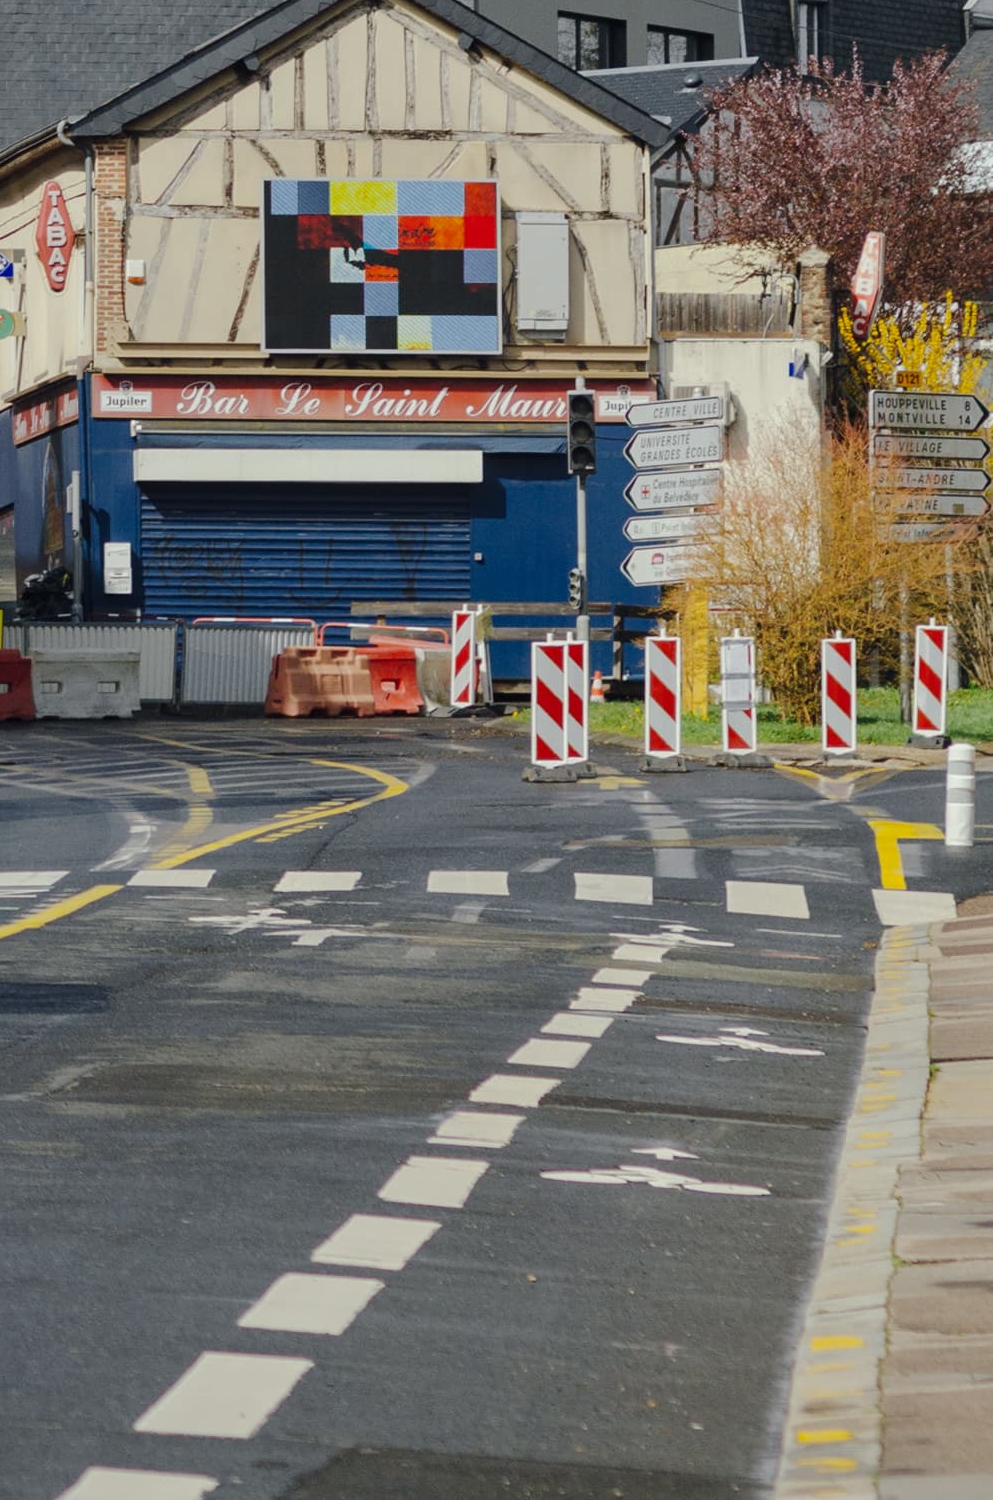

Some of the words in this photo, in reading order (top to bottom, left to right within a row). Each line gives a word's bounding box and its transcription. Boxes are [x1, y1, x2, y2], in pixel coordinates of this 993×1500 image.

[46, 190, 67, 283] TABAC
[853, 236, 878, 336] TABAC
[897, 373, 921, 385] D121
[105, 395, 148, 407] Jupiler
[175, 380, 251, 415] Bar
[275, 381, 321, 416] Le
[344, 382, 450, 417] Saint
[465, 384, 567, 418] Maur
[877, 397, 948, 411] HOUPPEVILLE
[653, 405, 687, 419] CENTRE
[693, 402, 718, 415] VILLE
[877, 412, 946, 425] MONTVILLE
[958, 414, 972, 426] 14
[640, 432, 691, 449] UNIVERSITÉ
[898, 441, 943, 453] VILLAGE
[640, 448, 682, 463] GRANDES
[653, 478, 677, 490] Centre
